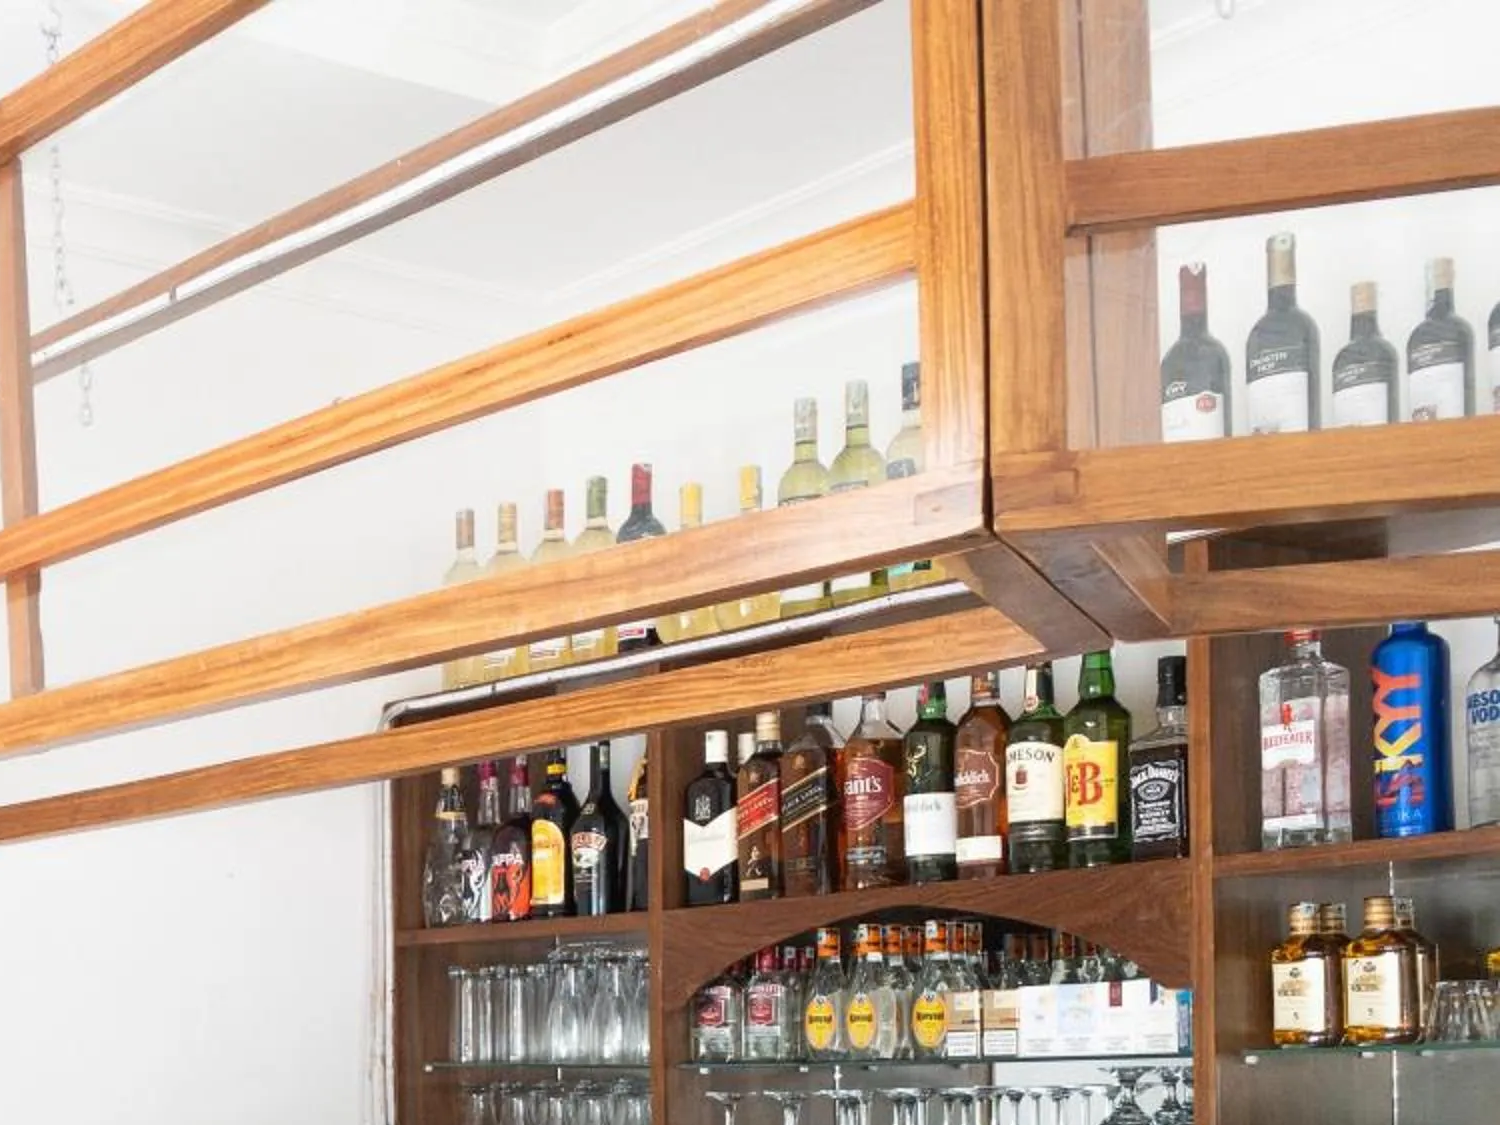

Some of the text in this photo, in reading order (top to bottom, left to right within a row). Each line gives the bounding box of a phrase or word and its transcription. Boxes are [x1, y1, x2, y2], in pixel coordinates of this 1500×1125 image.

[1467, 690, 1500, 708] ABSO
[1471, 708, 1500, 725] VOD
[1263, 731, 1313, 751] BEEFEATER
[1008, 748, 1055, 764] MESON
[844, 776, 882, 795] ant's
